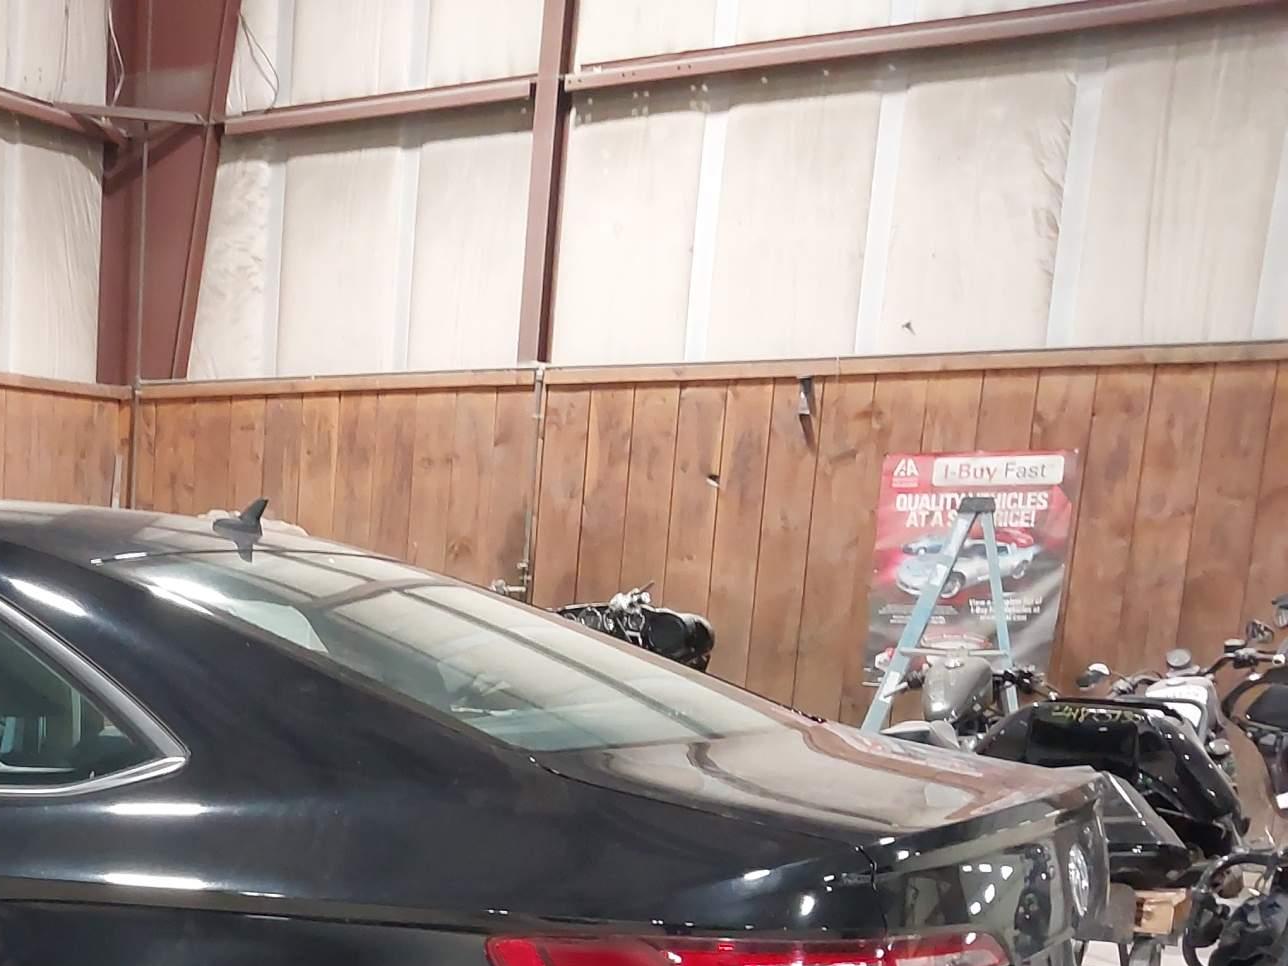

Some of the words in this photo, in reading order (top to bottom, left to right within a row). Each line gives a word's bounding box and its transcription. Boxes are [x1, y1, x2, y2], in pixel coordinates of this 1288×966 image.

[943, 463, 998, 481] I-Buy
[1004, 462, 1048, 479] Fast
[895, 492, 965, 511] QUALITY
[905, 510, 930, 528] AT
[930, 510, 944, 528] A
